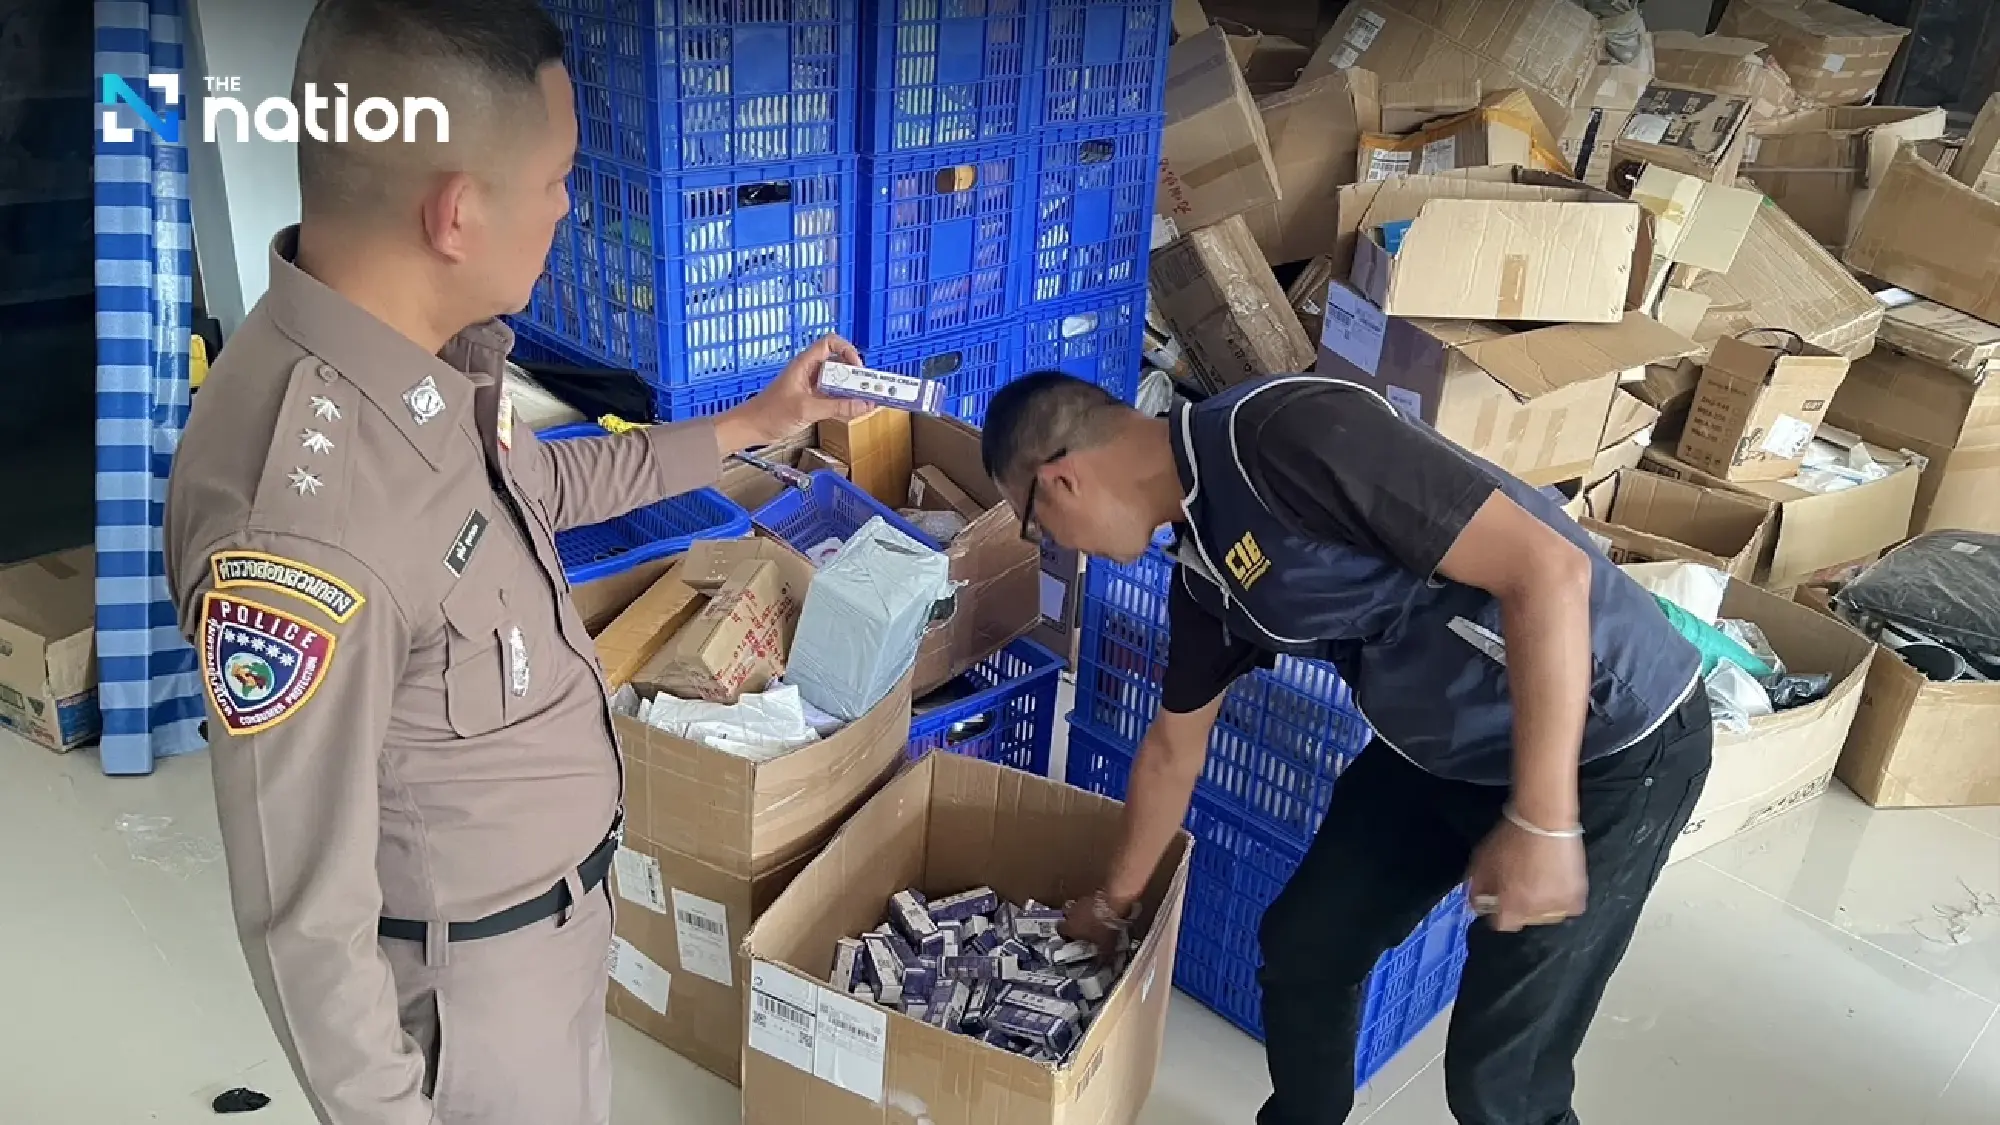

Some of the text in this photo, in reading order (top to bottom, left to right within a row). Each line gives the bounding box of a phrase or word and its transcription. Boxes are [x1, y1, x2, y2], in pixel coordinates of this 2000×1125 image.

[1225, 531, 1261, 580] CIB
[219, 601, 318, 649] POLICE
[285, 656, 319, 704] PROTECTION
